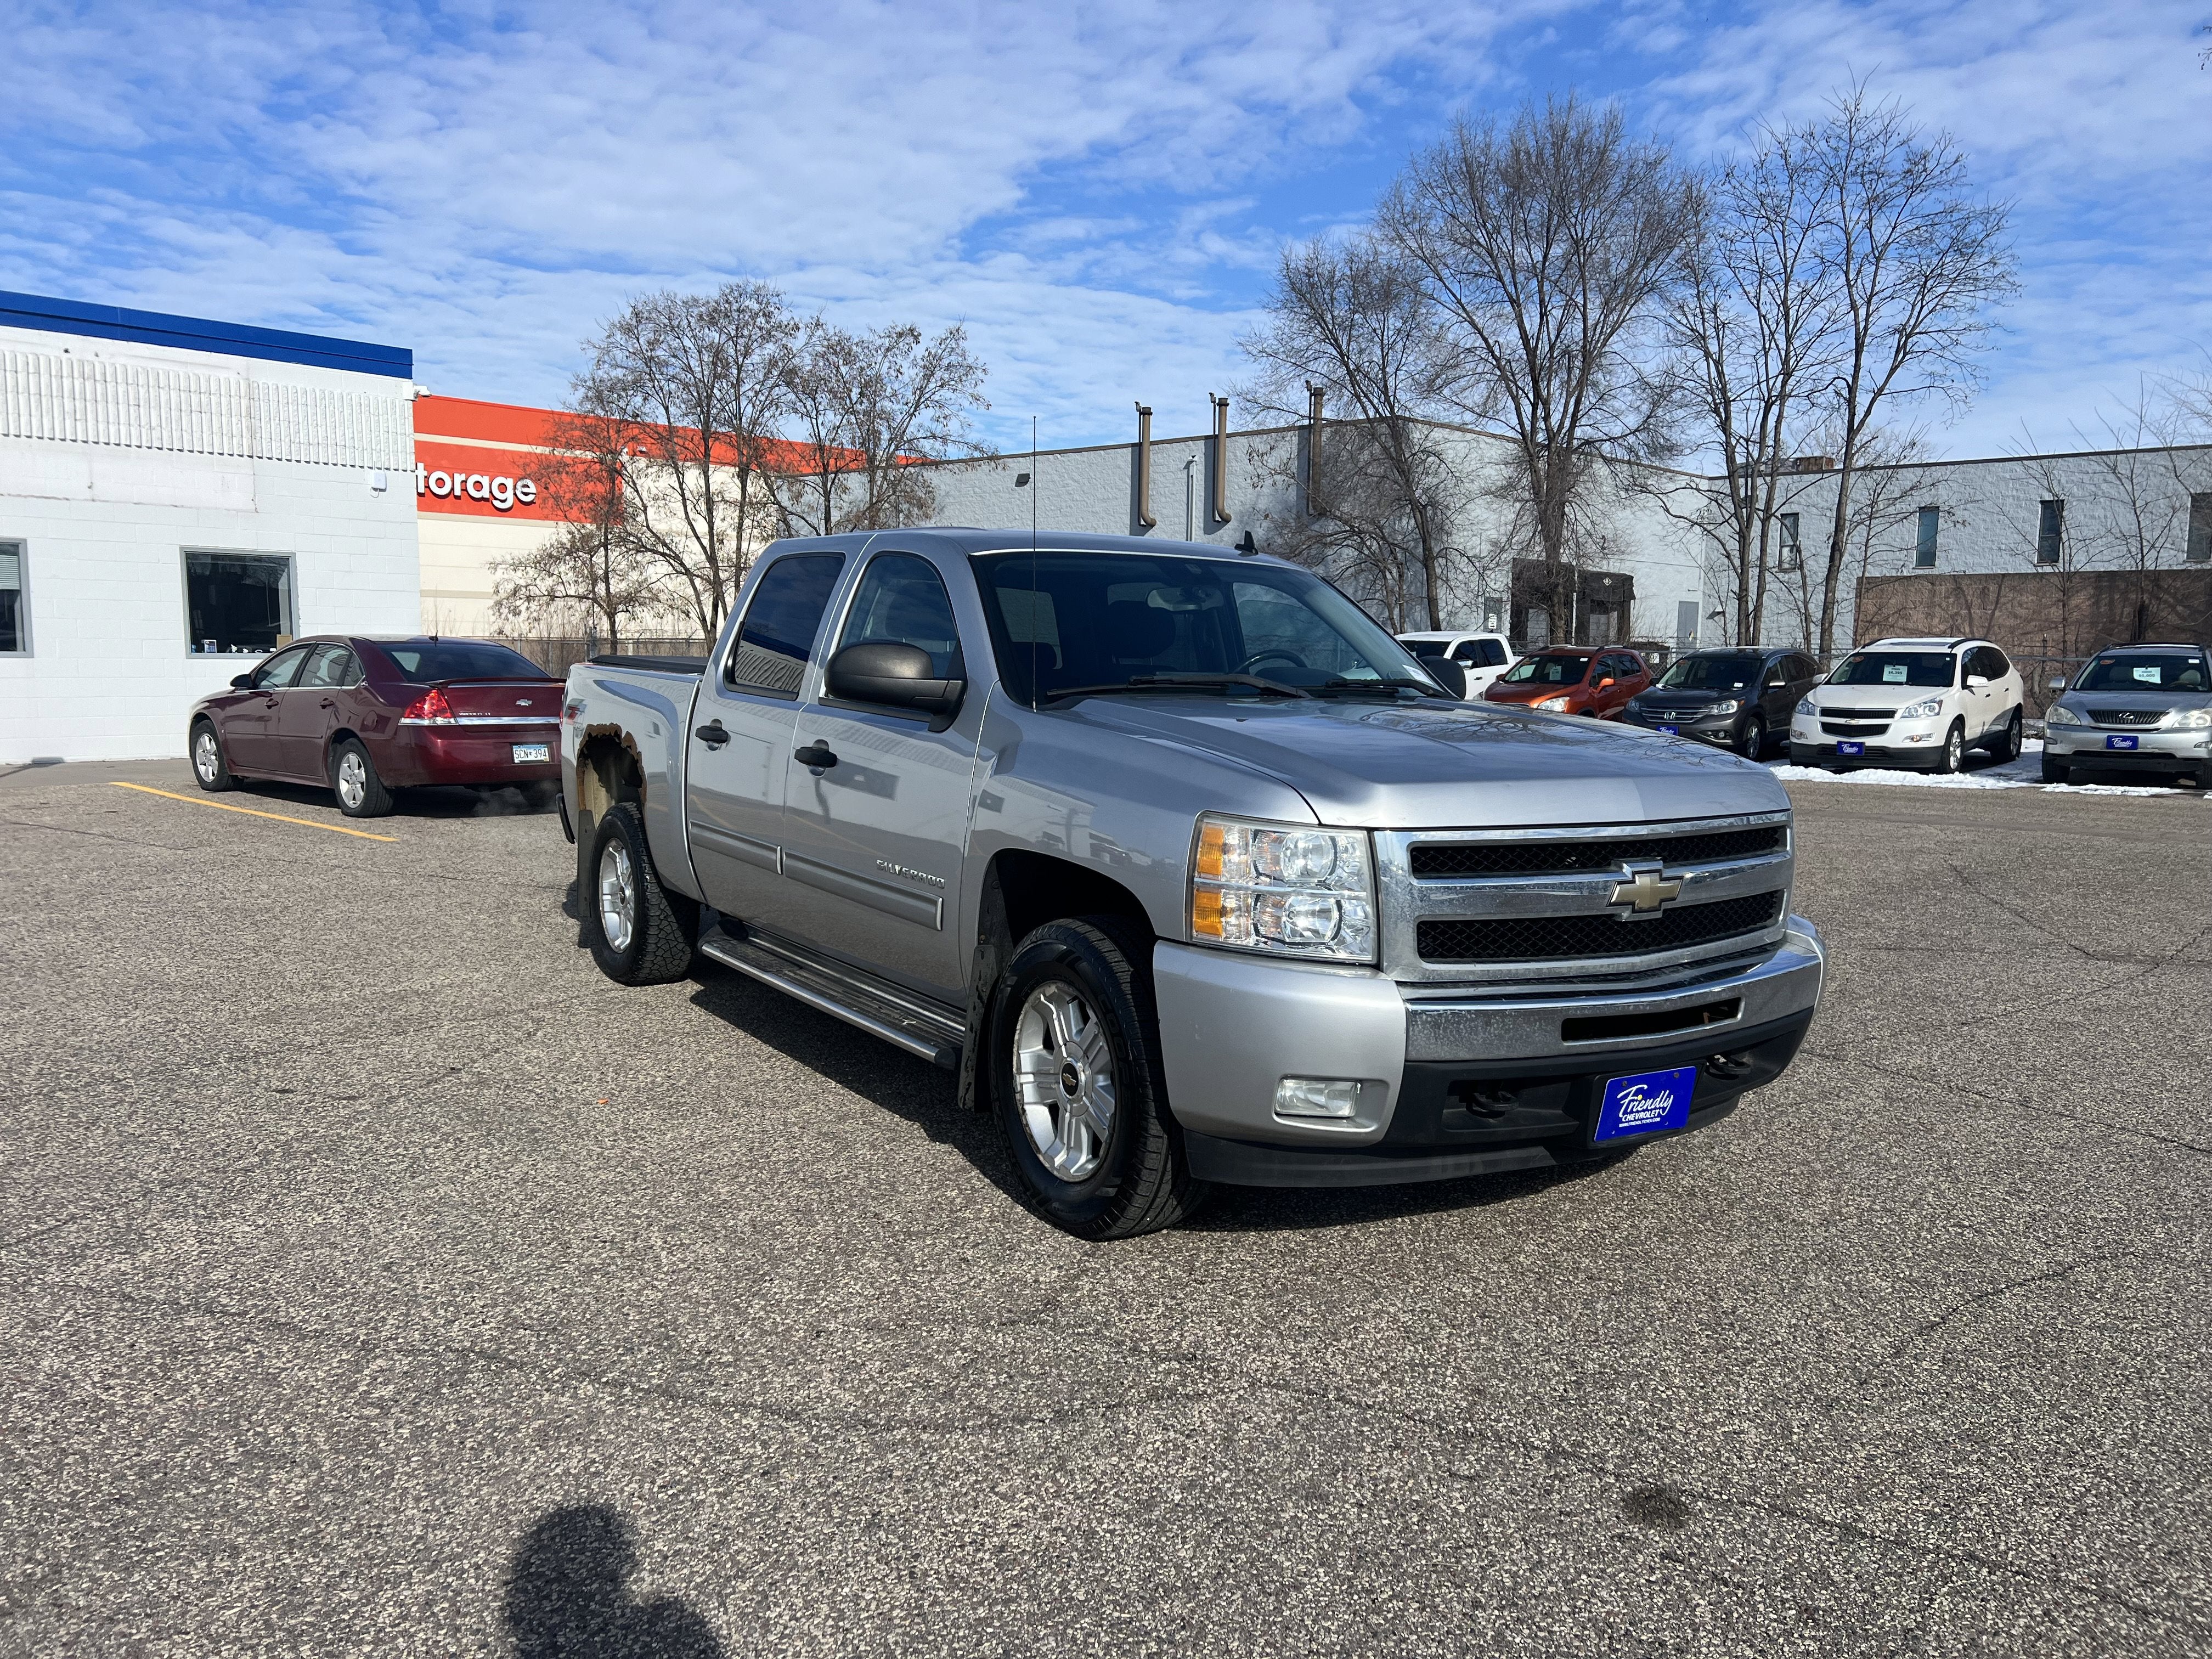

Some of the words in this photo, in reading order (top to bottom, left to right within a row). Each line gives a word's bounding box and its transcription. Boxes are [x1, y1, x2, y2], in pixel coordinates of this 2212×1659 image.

[415, 462, 537, 509] torage
[515, 749, 528, 759] SCN
[533, 749, 547, 758] 394
[1617, 1084, 1673, 1118] Friendly
[1622, 1109, 1660, 1121] CHEVROLET
